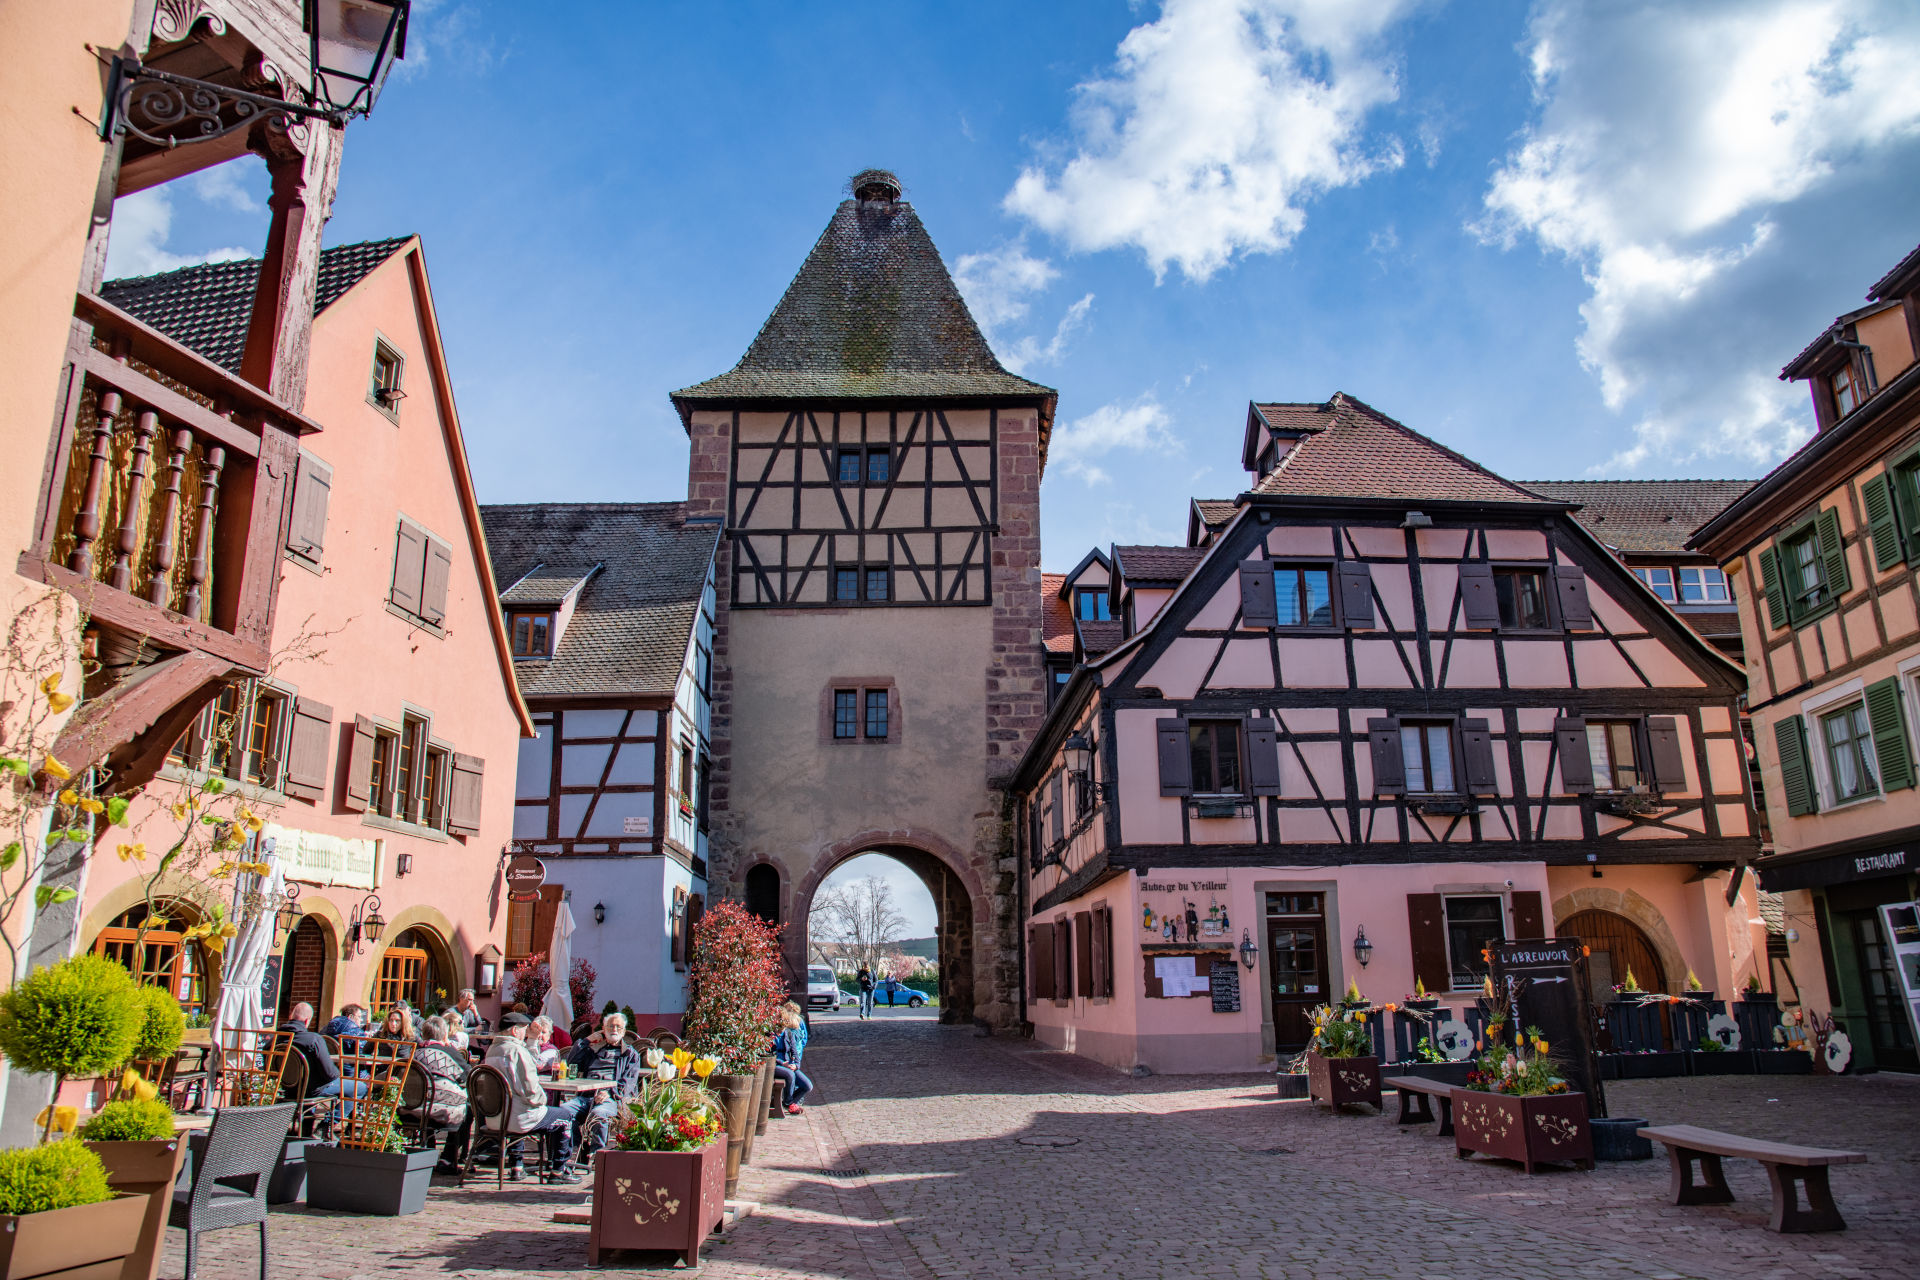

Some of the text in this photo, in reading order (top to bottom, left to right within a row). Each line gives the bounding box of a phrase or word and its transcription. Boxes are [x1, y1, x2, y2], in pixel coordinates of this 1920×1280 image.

[1855, 851, 1906, 873] RESTAURANT
[1140, 881, 1228, 894] Auberge du Veilleur
[1501, 949, 1571, 964] L'ABREUVOIR
